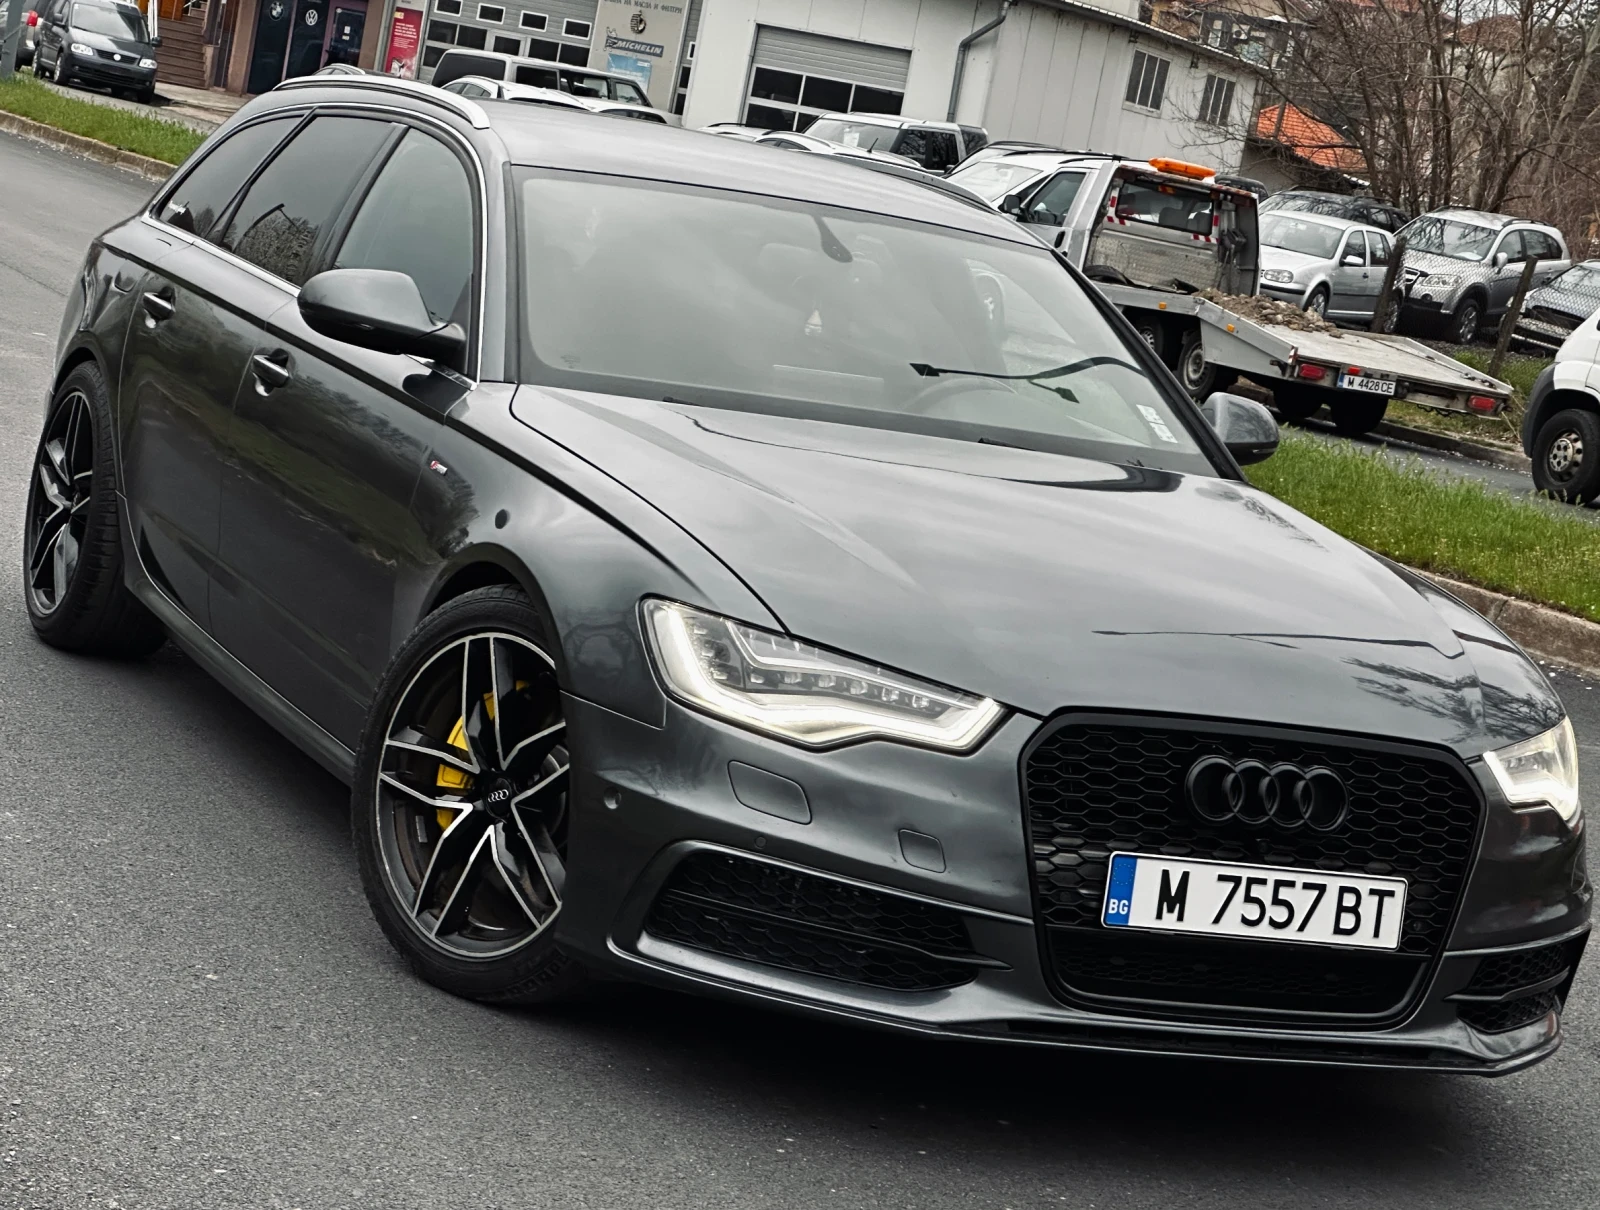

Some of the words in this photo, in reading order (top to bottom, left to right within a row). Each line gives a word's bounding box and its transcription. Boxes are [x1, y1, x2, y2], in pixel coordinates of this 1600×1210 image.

[633, 0, 652, 9] МАСЛА
[616, 40, 662, 54] MICHELIN
[1347, 377, 1355, 387] M
[1358, 379, 1380, 391] 4428
[1108, 898, 1129, 915] BG
[1155, 869, 1190, 922] M
[1211, 873, 1327, 932] 7557
[1332, 885, 1396, 938] BT
